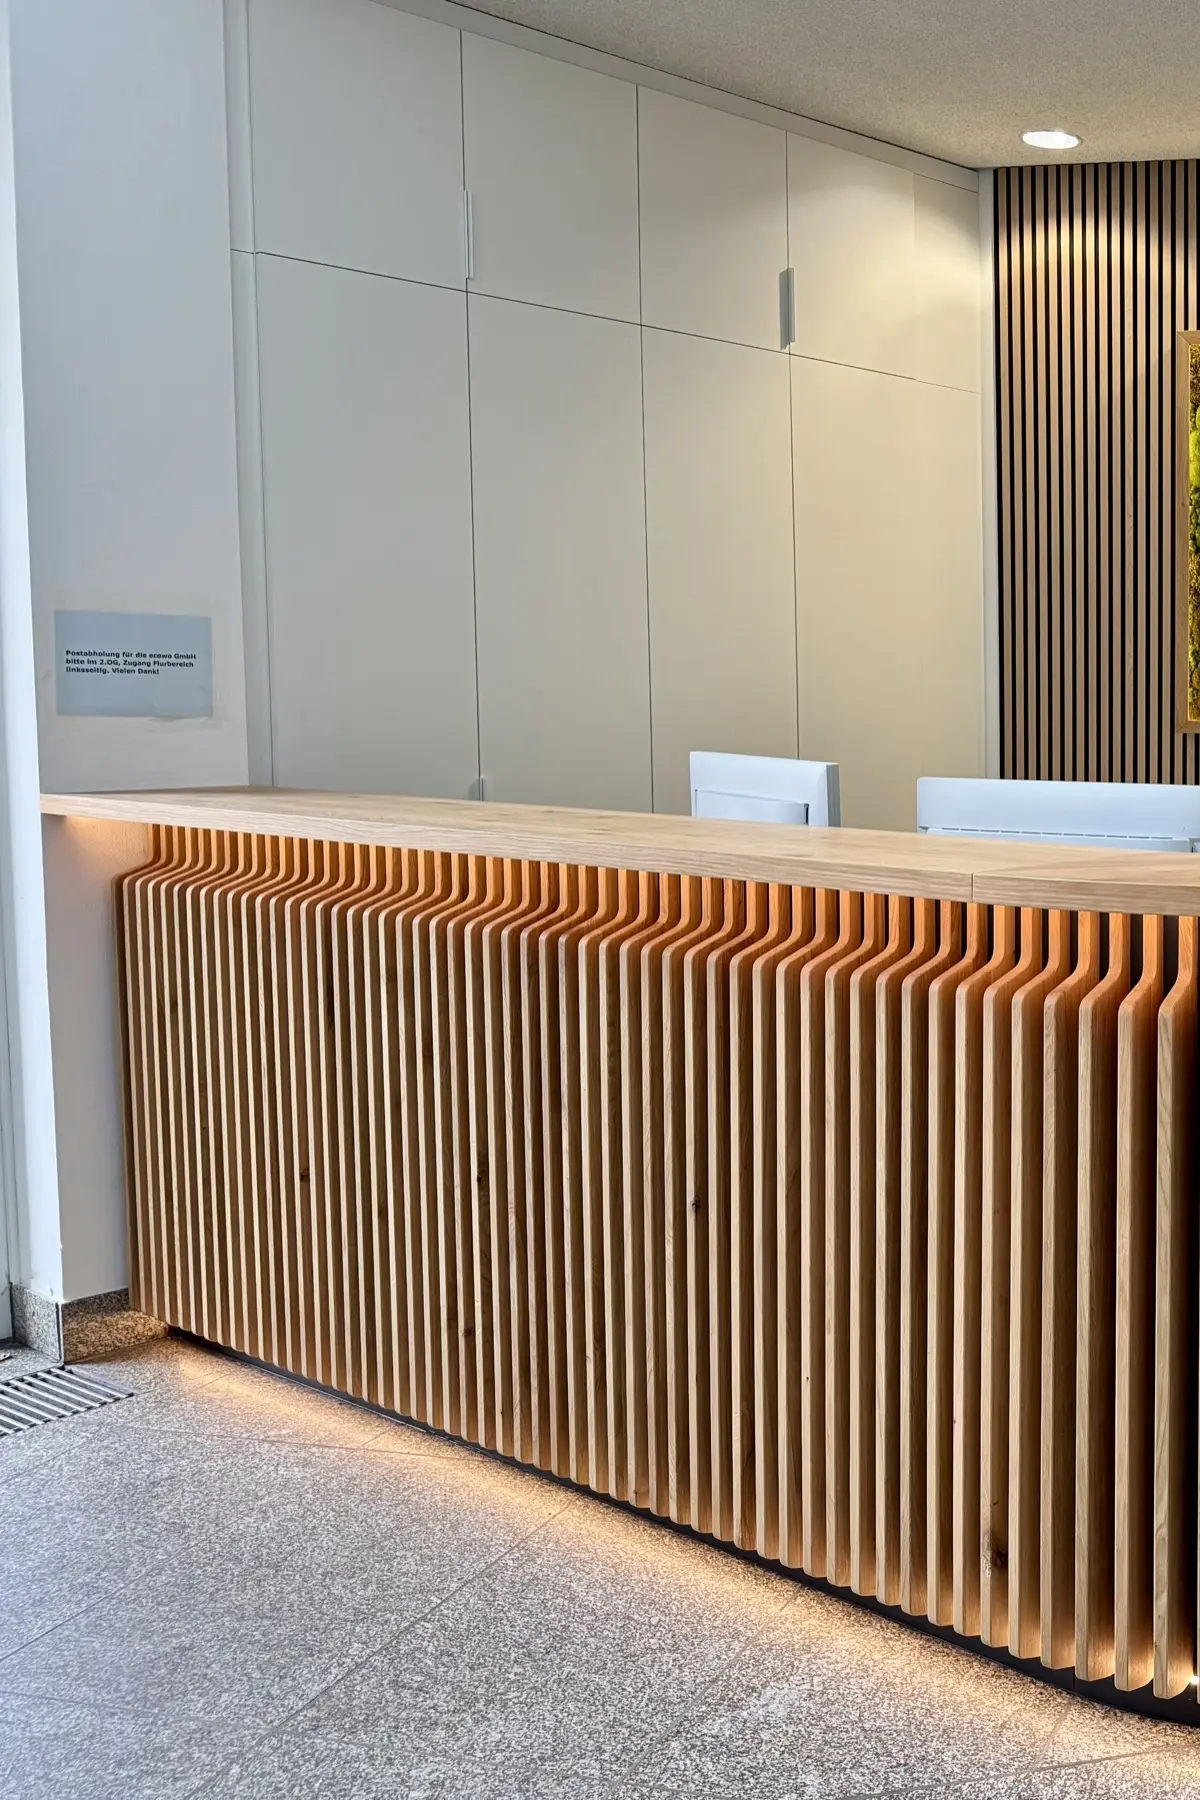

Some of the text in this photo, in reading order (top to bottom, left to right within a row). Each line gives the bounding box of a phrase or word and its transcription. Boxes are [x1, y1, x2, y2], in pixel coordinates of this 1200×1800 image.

[65, 650, 120, 659] Postabholung
[153, 660, 194, 668] Flurbereich
[66, 666, 110, 675] linksseitig.
